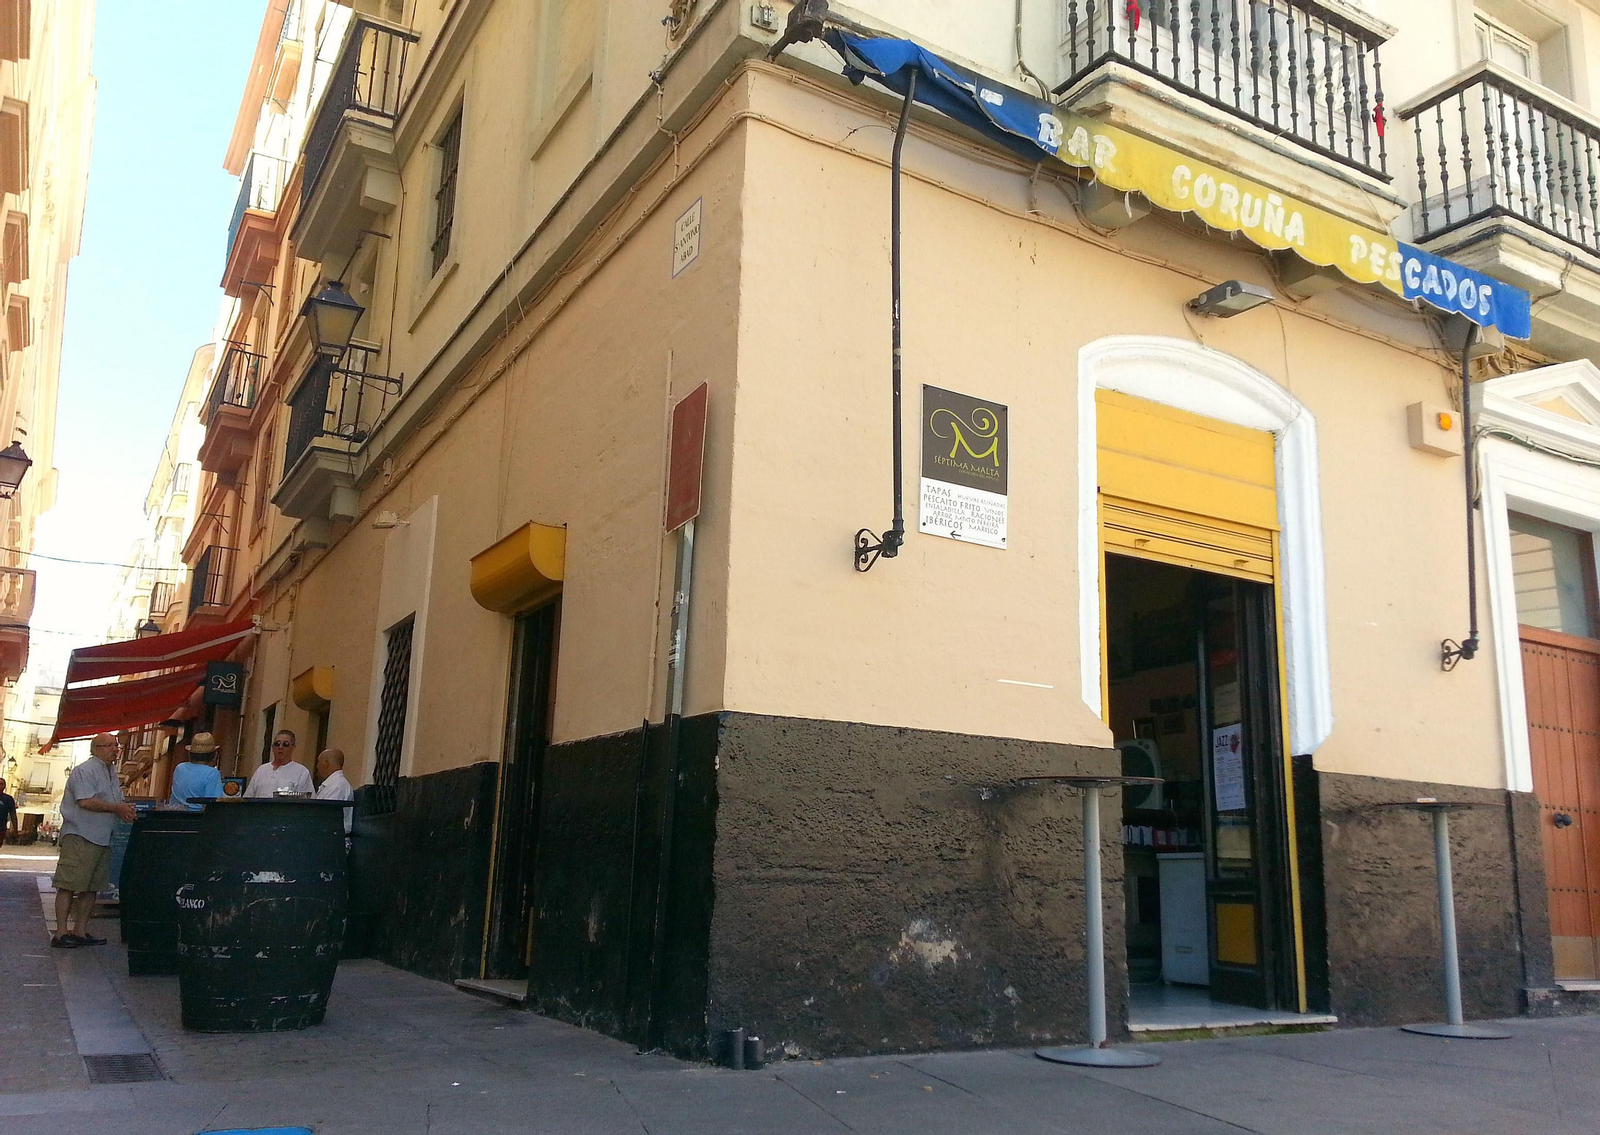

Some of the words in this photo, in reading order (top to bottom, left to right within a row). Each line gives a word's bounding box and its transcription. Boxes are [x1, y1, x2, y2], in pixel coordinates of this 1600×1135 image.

[1038, 112, 1117, 174] BAR
[1171, 164, 1305, 247] CORUÑA
[1349, 233, 1493, 316] PESCADOS
[681, 211, 696, 232] CALLE
[680, 245, 694, 263] ABAD
[970, 464, 1000, 478] MALTA
[926, 485, 951, 497] TAPAS
[923, 493, 958, 507] PESCAITO
[960, 501, 981, 512] FRITO
[932, 510, 953, 520] ARROZ
[971, 511, 1005, 525] RACIONES
[984, 507, 1004, 517] VINOS
[925, 515, 963, 531] IBÉRICOS
[968, 524, 999, 535] MARISCO
[1215, 735, 1228, 748] JAZZ
